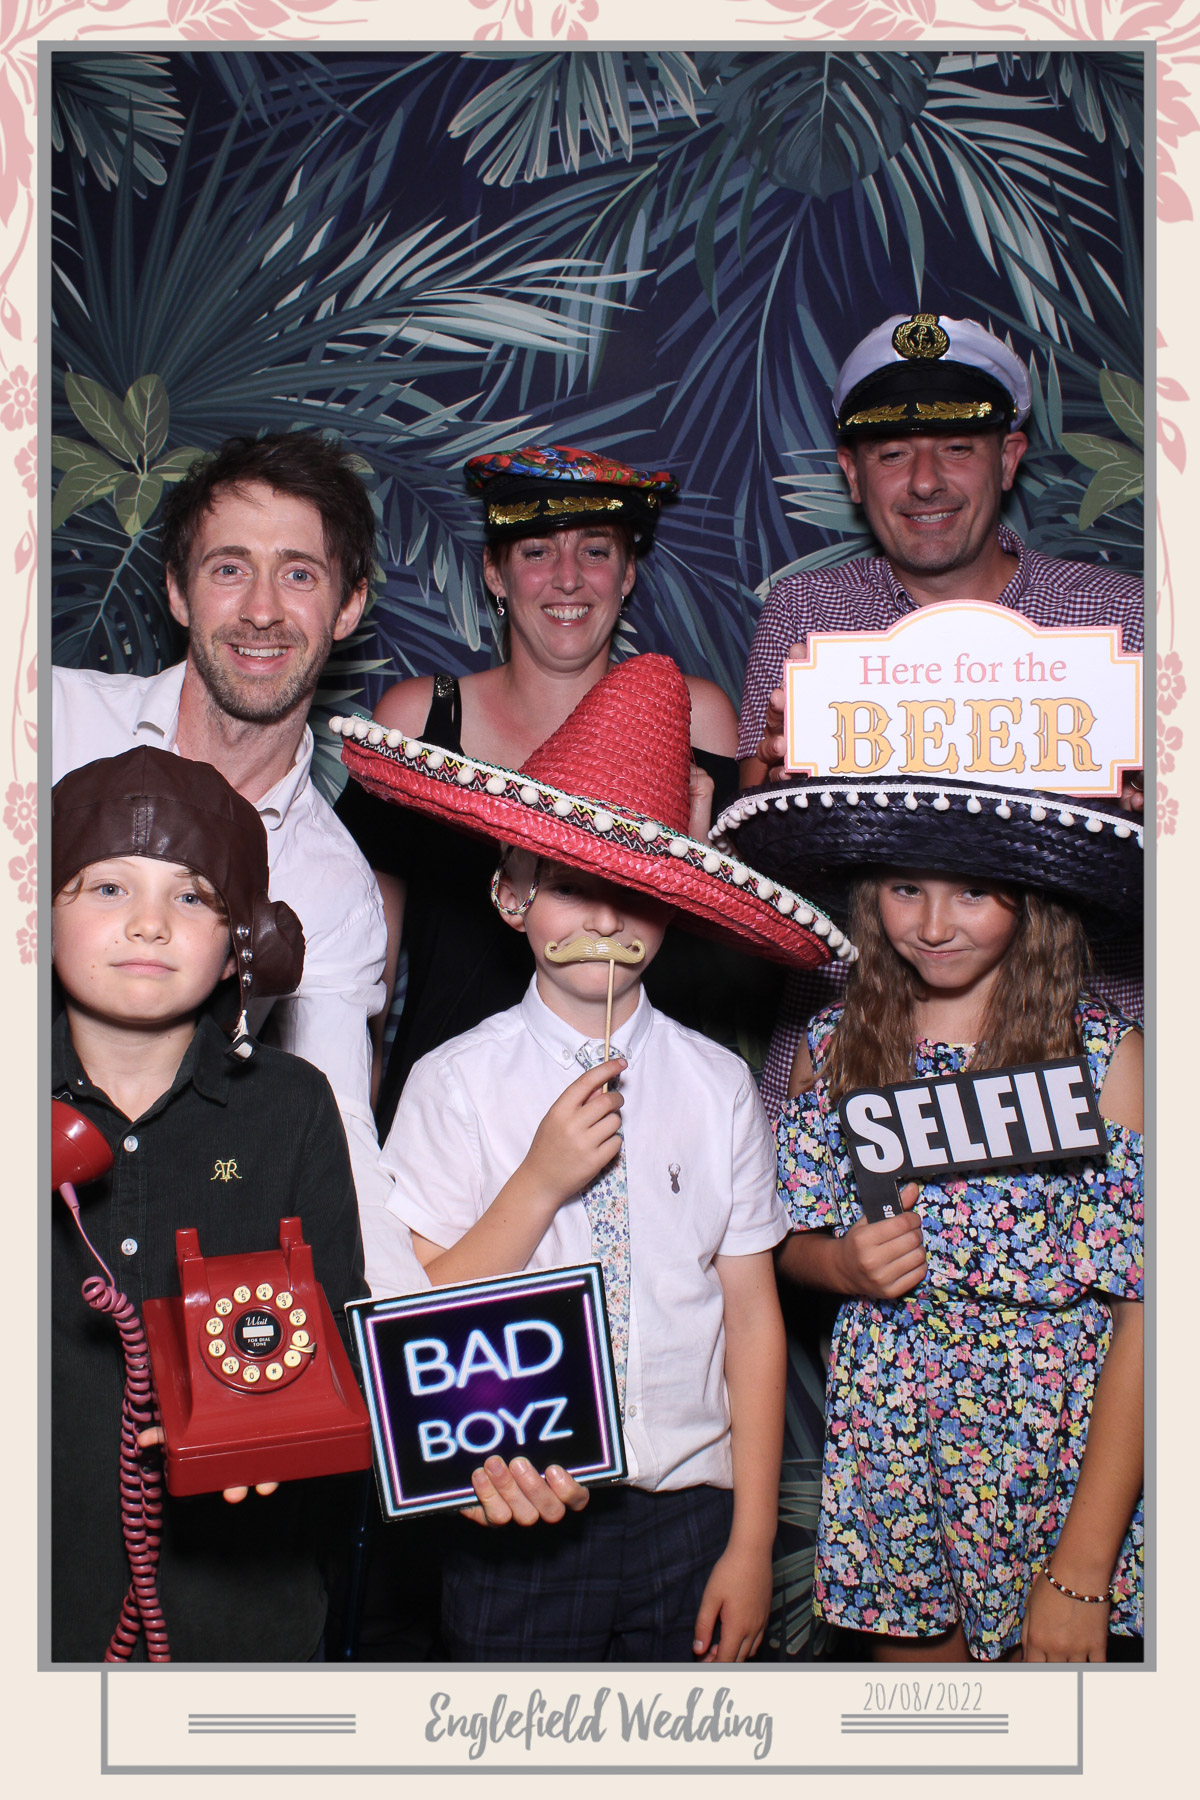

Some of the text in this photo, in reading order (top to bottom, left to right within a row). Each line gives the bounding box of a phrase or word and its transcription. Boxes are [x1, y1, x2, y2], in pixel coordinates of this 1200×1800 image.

[859, 651, 1067, 686] Here for the
[828, 696, 1102, 775] BEER
[845, 1065, 1100, 1174] SELFIE
[222, 1305, 228, 1313] 6
[215, 1346, 220, 1354] 8
[403, 1319, 564, 1397] BAD
[249, 1372, 255, 1380] 0
[417, 1397, 574, 1463] BOYZ
